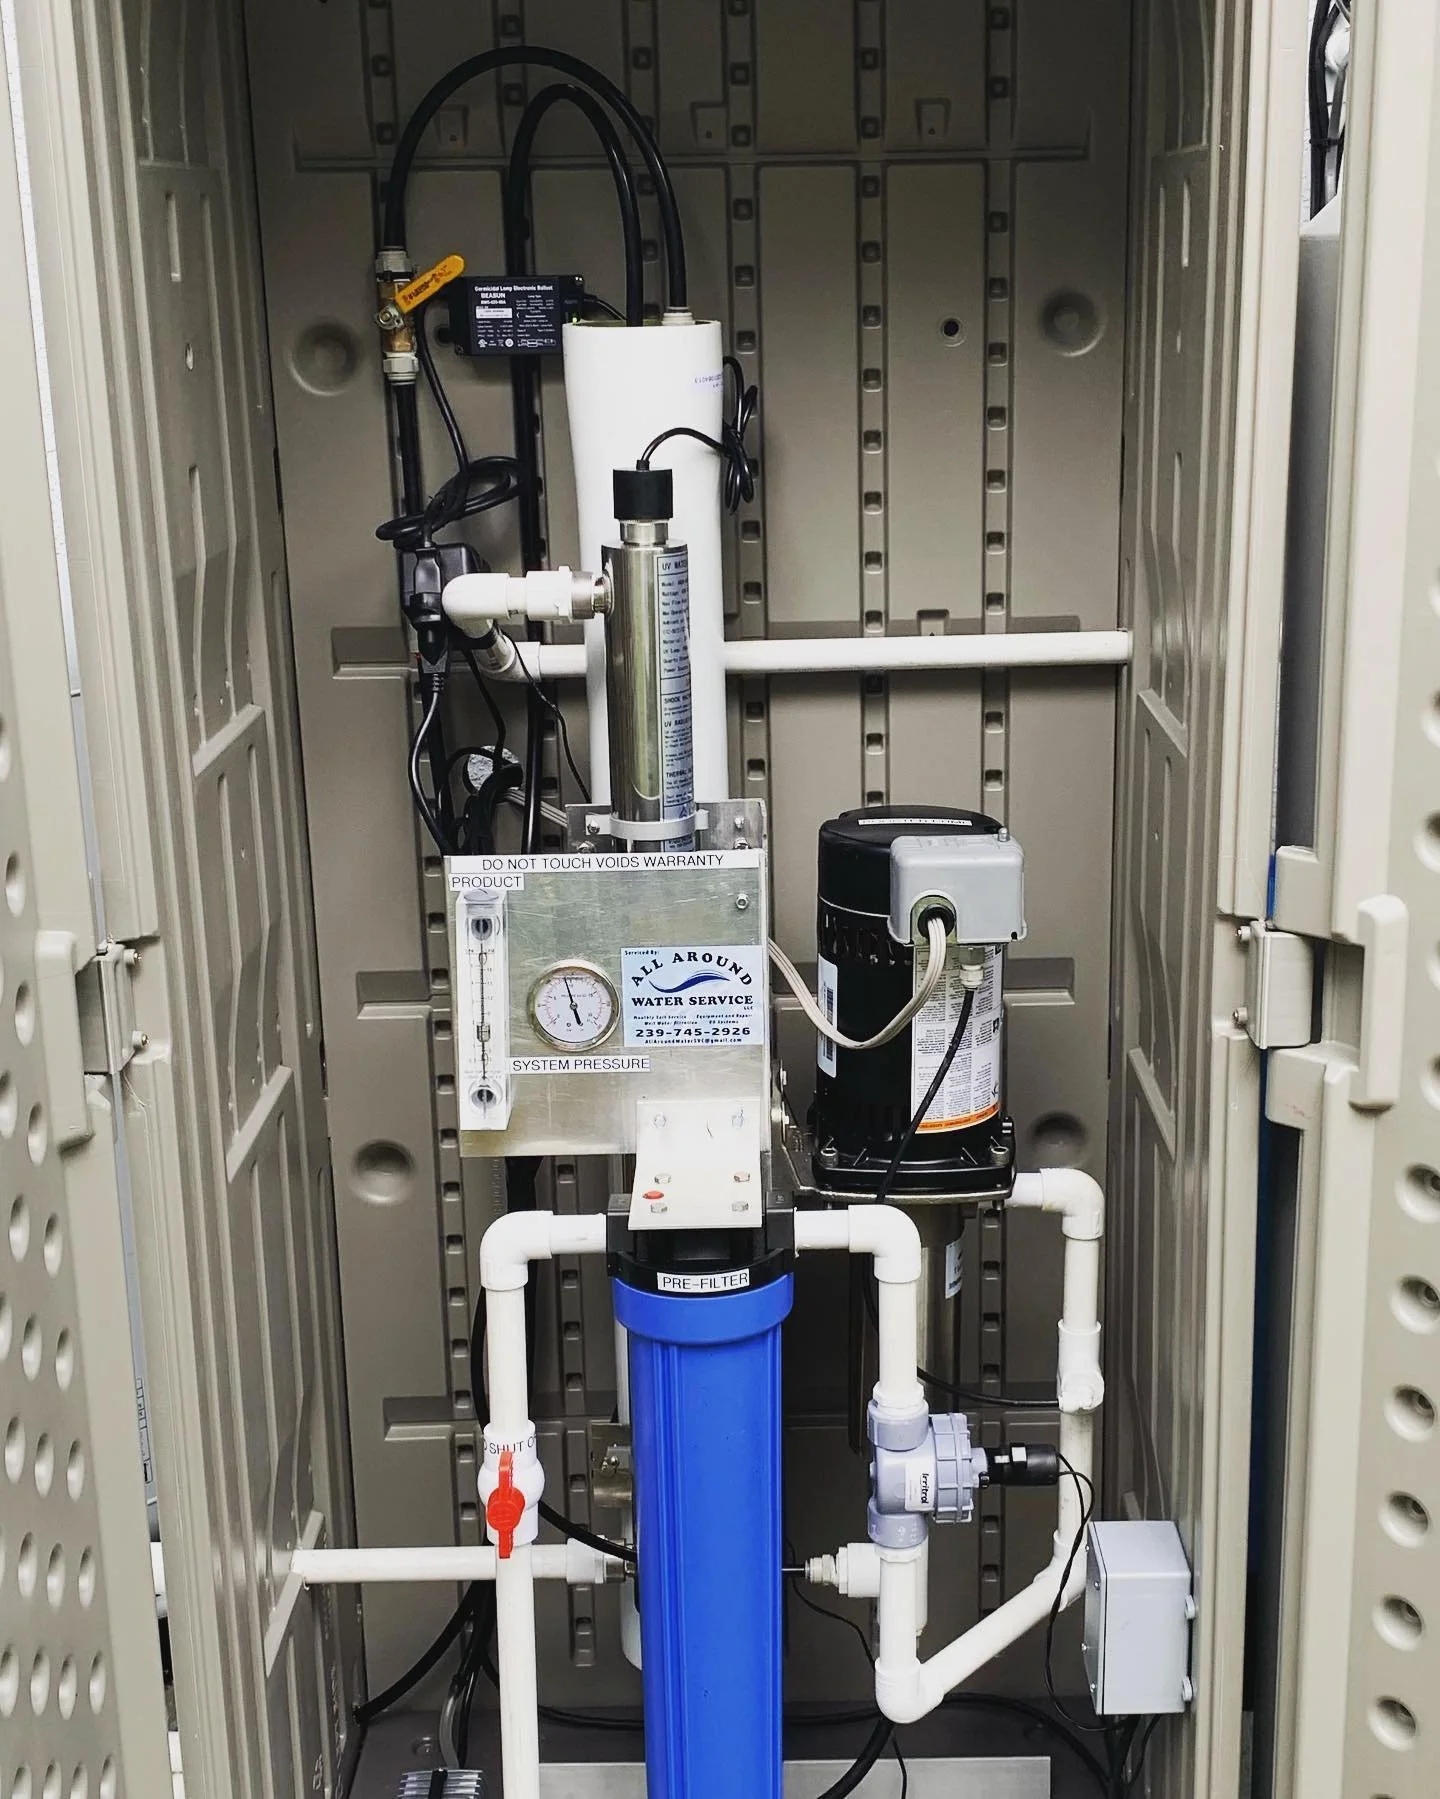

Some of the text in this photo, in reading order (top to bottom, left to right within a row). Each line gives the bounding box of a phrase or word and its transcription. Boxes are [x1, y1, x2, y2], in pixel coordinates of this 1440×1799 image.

[482, 854, 724, 871] DO NOT TOUCH VOIDS WARRANTY
[452, 876, 522, 888] PRODUCT
[631, 951, 753, 987] ALL AROUND
[631, 995, 754, 1007] WATER SERVICE
[635, 1026, 751, 1038] 239-745-2926
[513, 1058, 650, 1071] SYSTEM PRESSURE
[663, 1272, 748, 1290] PRE-FILTER
[920, 1472, 930, 1504] Irritrol
